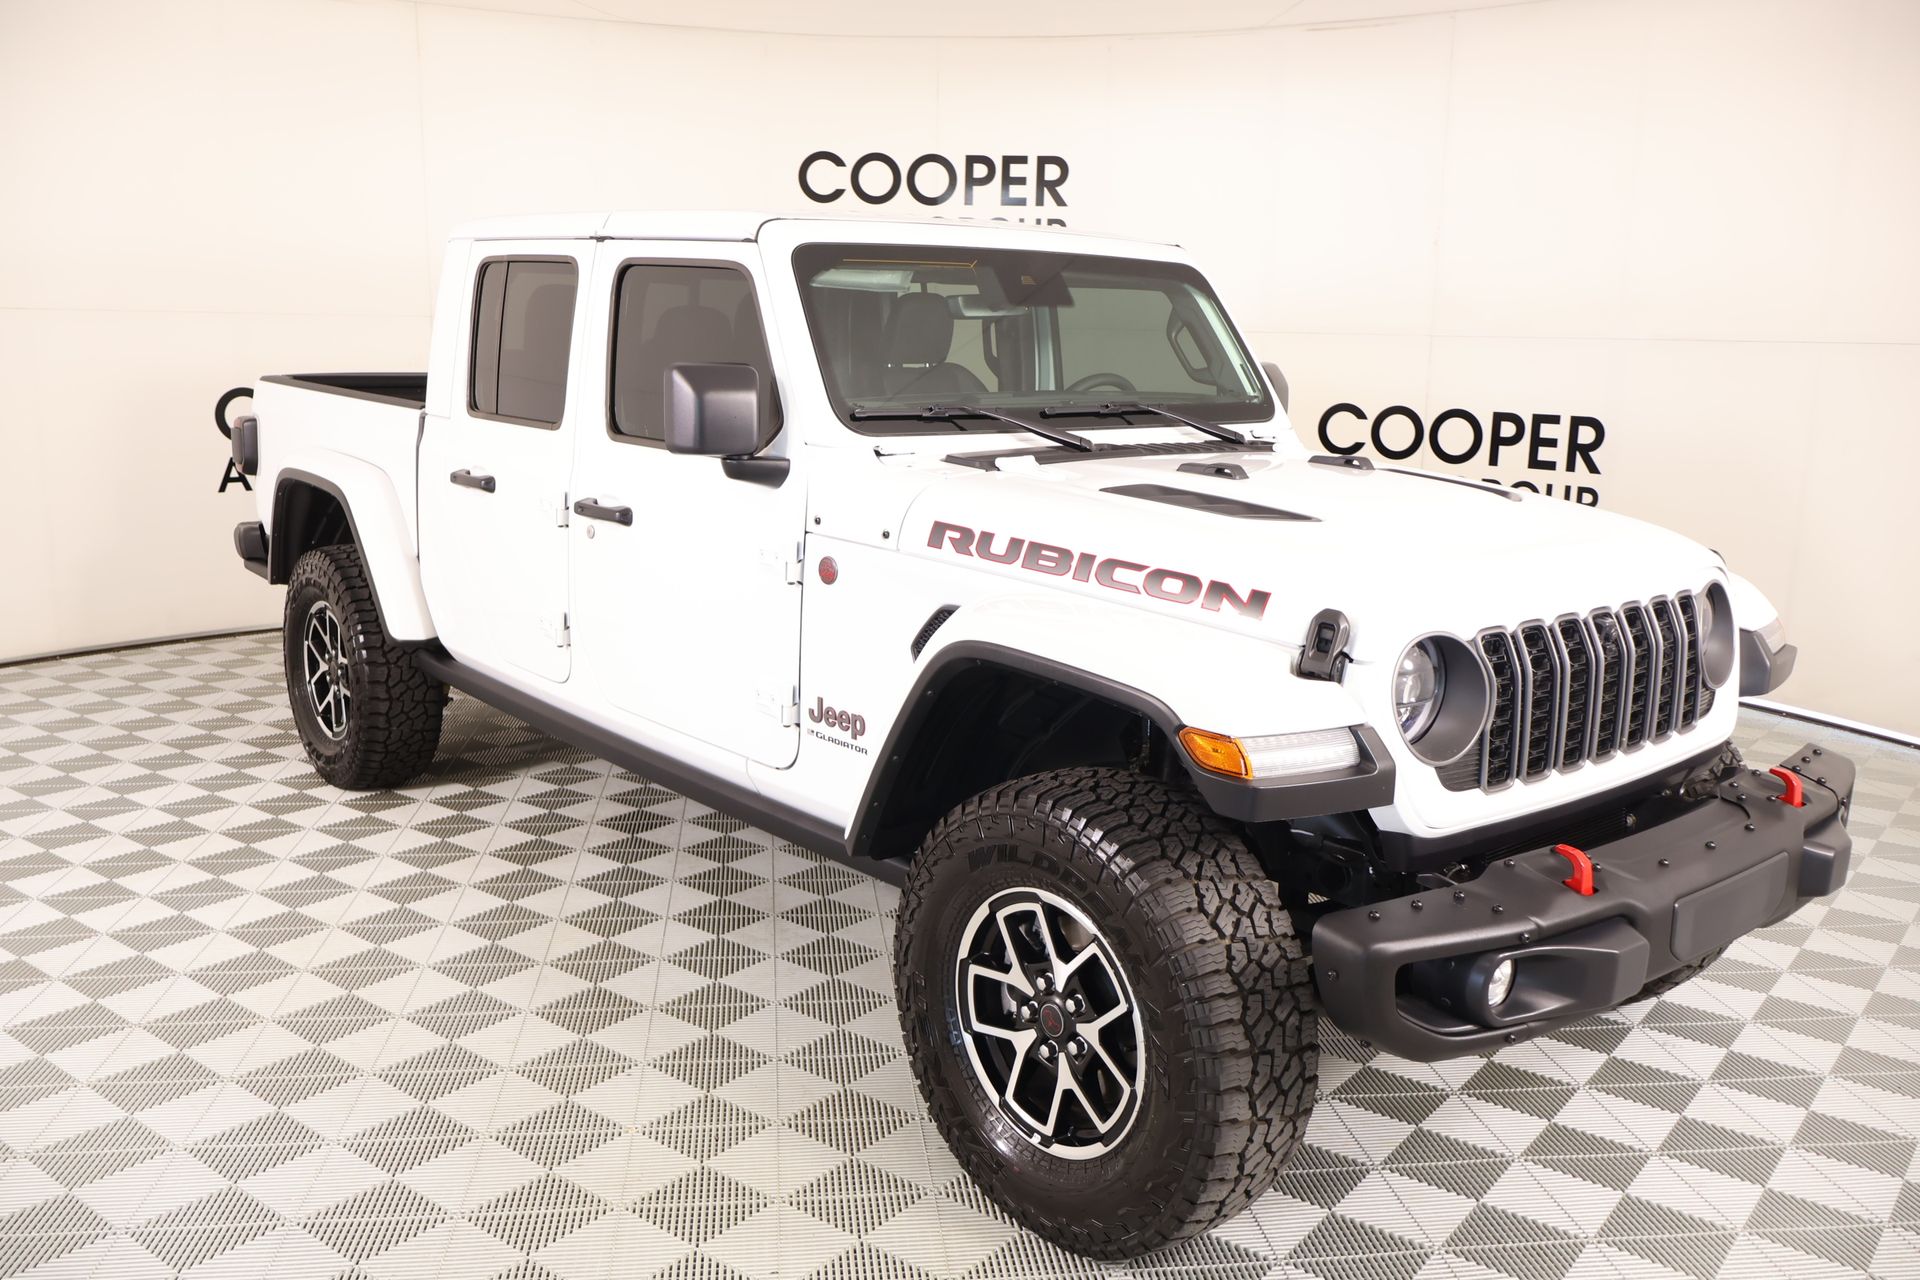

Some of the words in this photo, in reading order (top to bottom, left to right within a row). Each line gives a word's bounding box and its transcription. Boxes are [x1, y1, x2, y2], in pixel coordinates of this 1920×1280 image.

[798, 150, 1070, 207] COOPER
[1318, 402, 1606, 475] COOPER
[926, 520, 1272, 621] RUBICON
[808, 696, 866, 741] Jeep
[815, 730, 868, 756] GLADIATOR
